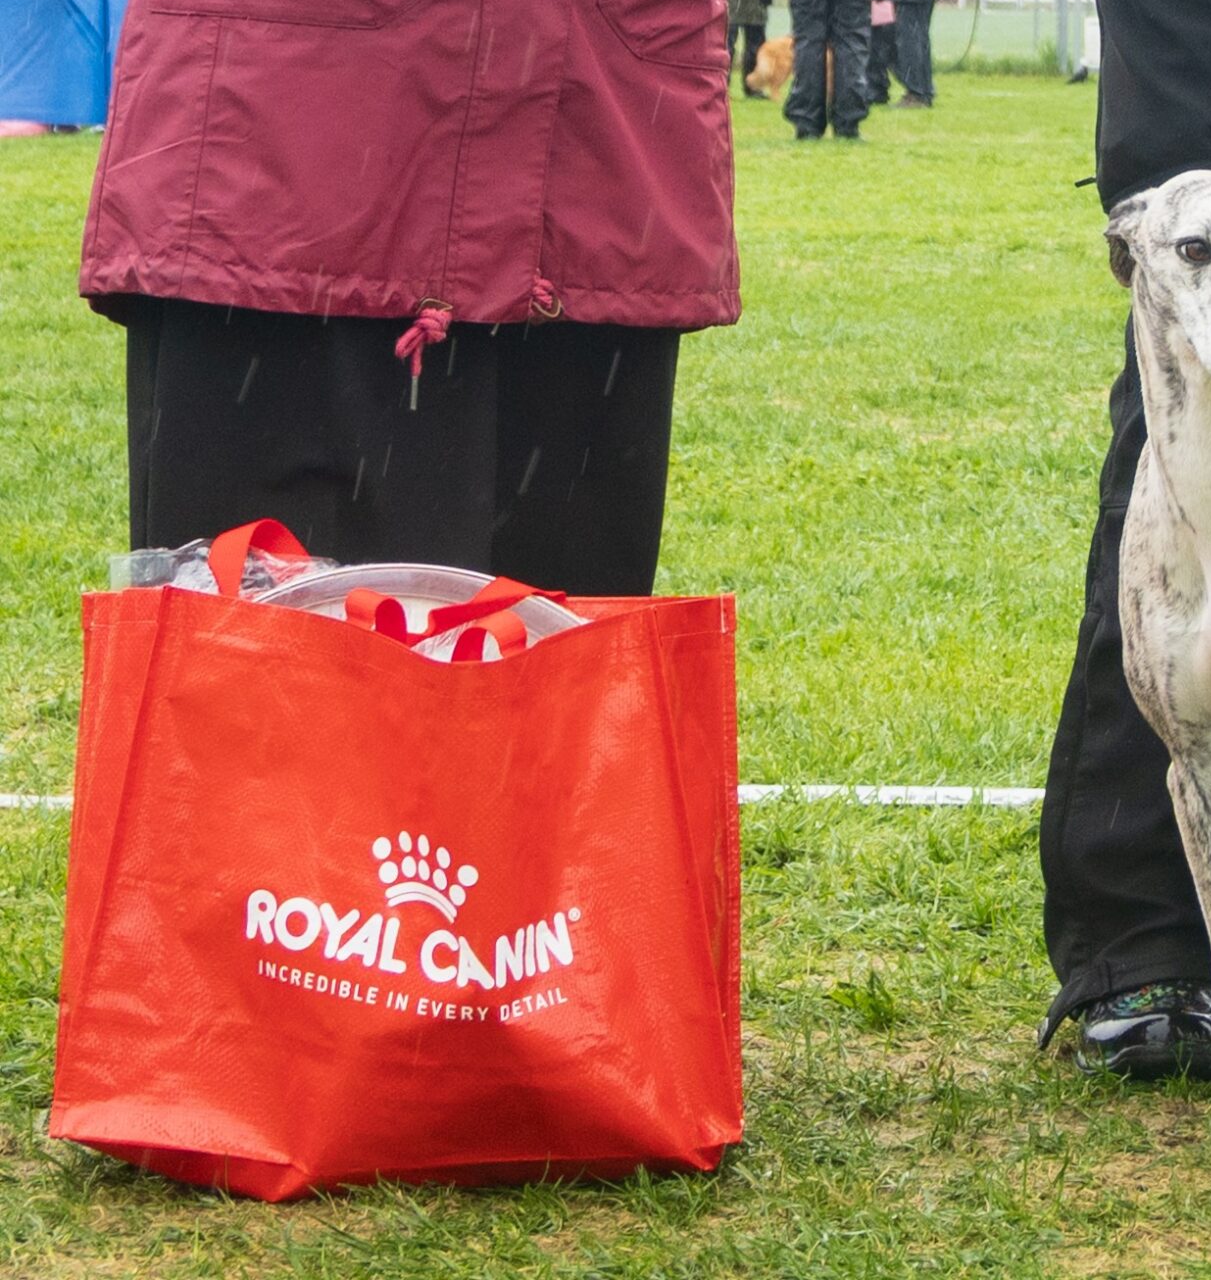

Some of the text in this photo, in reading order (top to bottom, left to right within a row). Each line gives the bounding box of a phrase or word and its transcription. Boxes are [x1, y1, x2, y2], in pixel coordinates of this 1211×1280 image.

[246, 888, 407, 974] ROYAL
[258, 958, 569, 1022] INCREDIBLE IN EVERY DETAIL
